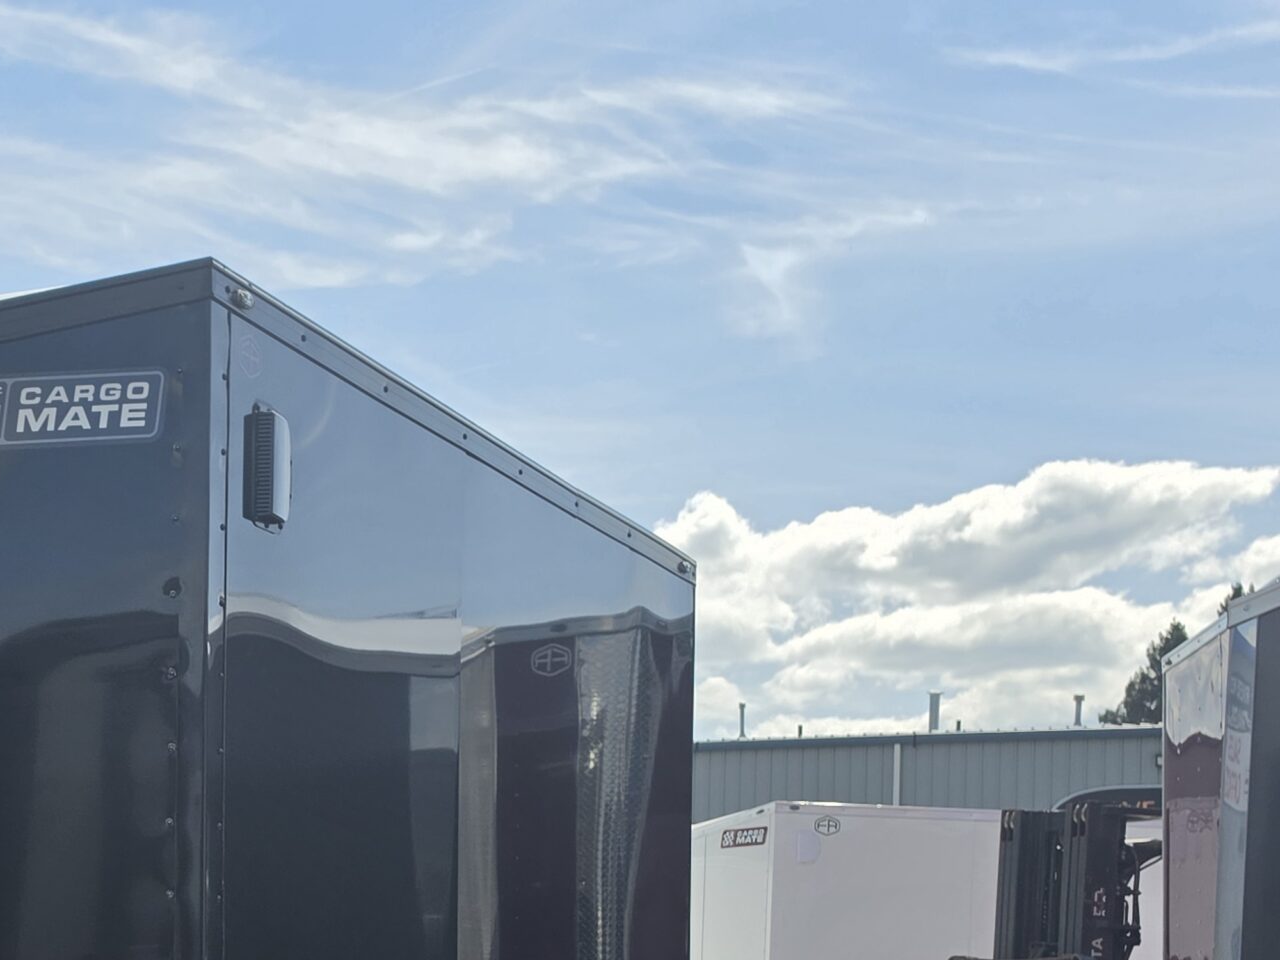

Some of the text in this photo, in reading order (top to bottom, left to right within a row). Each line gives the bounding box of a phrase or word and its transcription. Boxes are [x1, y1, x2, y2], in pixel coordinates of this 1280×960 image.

[19, 381, 150, 405] CARGO
[16, 402, 148, 433] MATE
[735, 834, 764, 845] MATE
